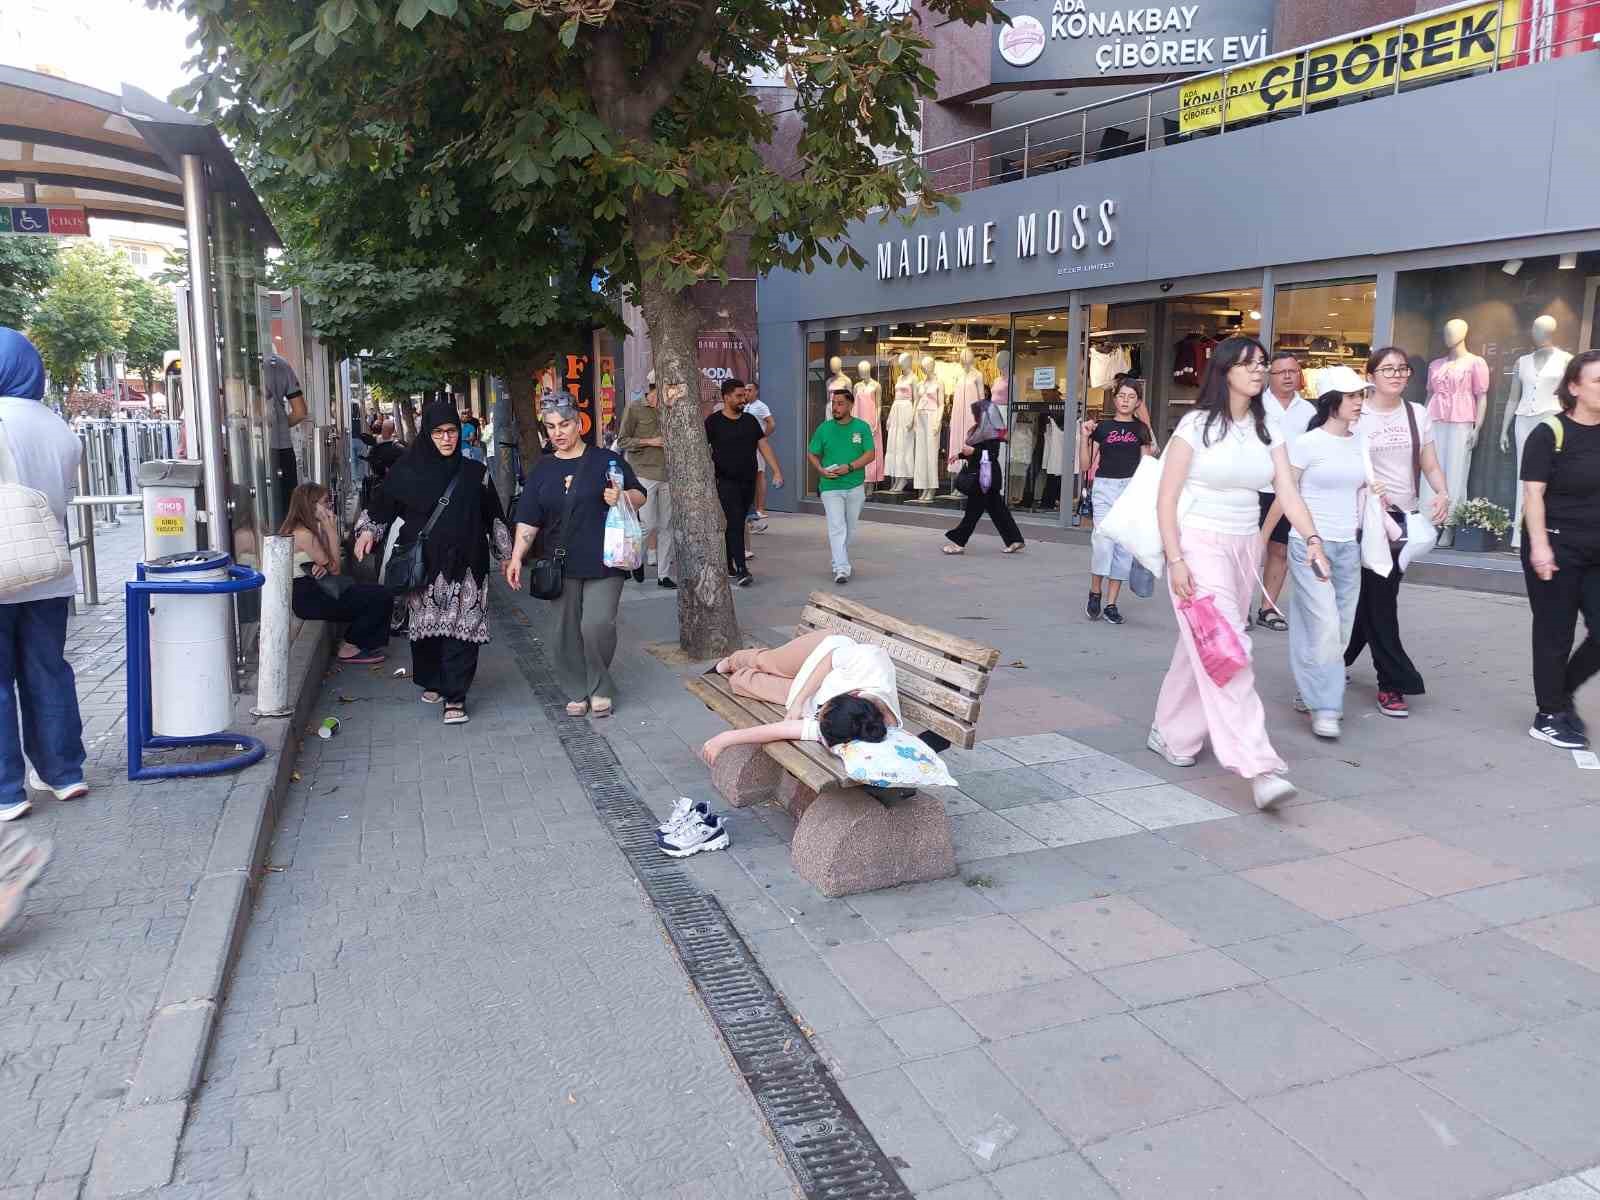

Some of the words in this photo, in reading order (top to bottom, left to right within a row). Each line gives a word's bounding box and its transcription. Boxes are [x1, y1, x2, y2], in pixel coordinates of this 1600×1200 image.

[1051, 6, 1198, 39] KONAKBAY
[1052, 0, 1086, 14] ADA
[1095, 36, 1215, 72] ÇİBÖREK
[1223, 28, 1268, 62] EVİ
[1260, 10, 1499, 111] ÇİBÖREK
[877, 221, 996, 281] MADAME
[1017, 199, 1114, 259] MOSS
[1107, 430, 1138, 444] Barbie
